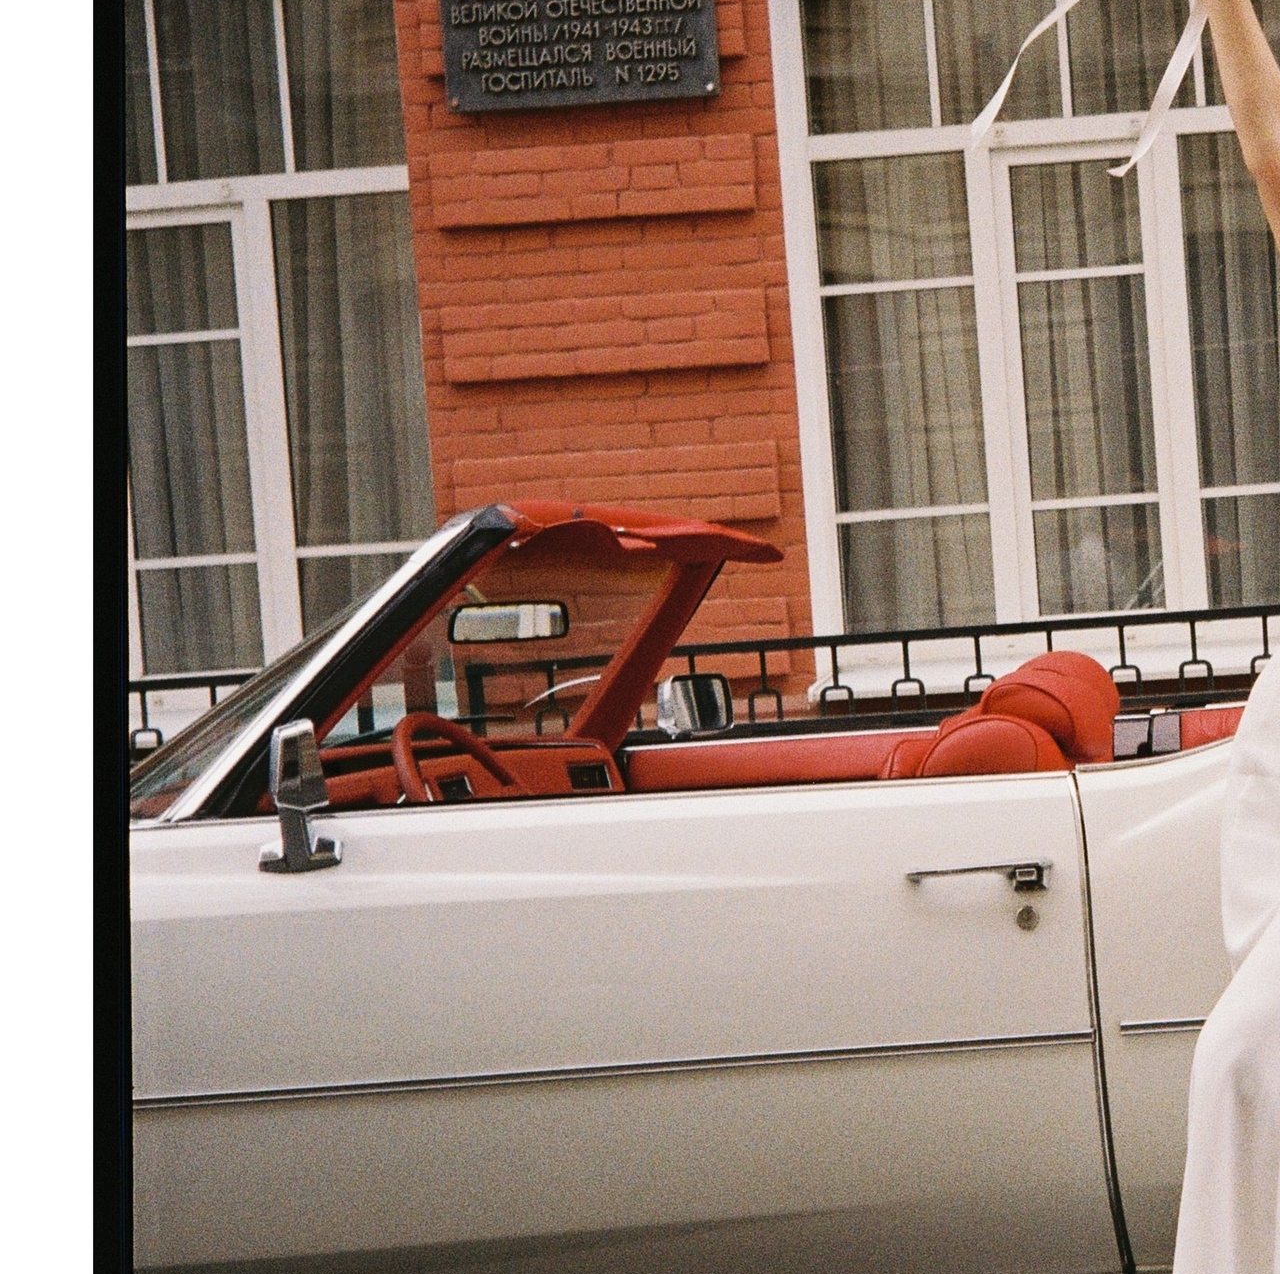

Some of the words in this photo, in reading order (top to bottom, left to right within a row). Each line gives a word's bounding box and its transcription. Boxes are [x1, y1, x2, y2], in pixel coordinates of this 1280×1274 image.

[478, 23, 549, 47] ВОЙНЫ
[605, 35, 698, 62] ВОЕННЫЙ
[481, 67, 594, 94] ГОСПИТАЛЬ
[637, 61, 680, 83] 1295
